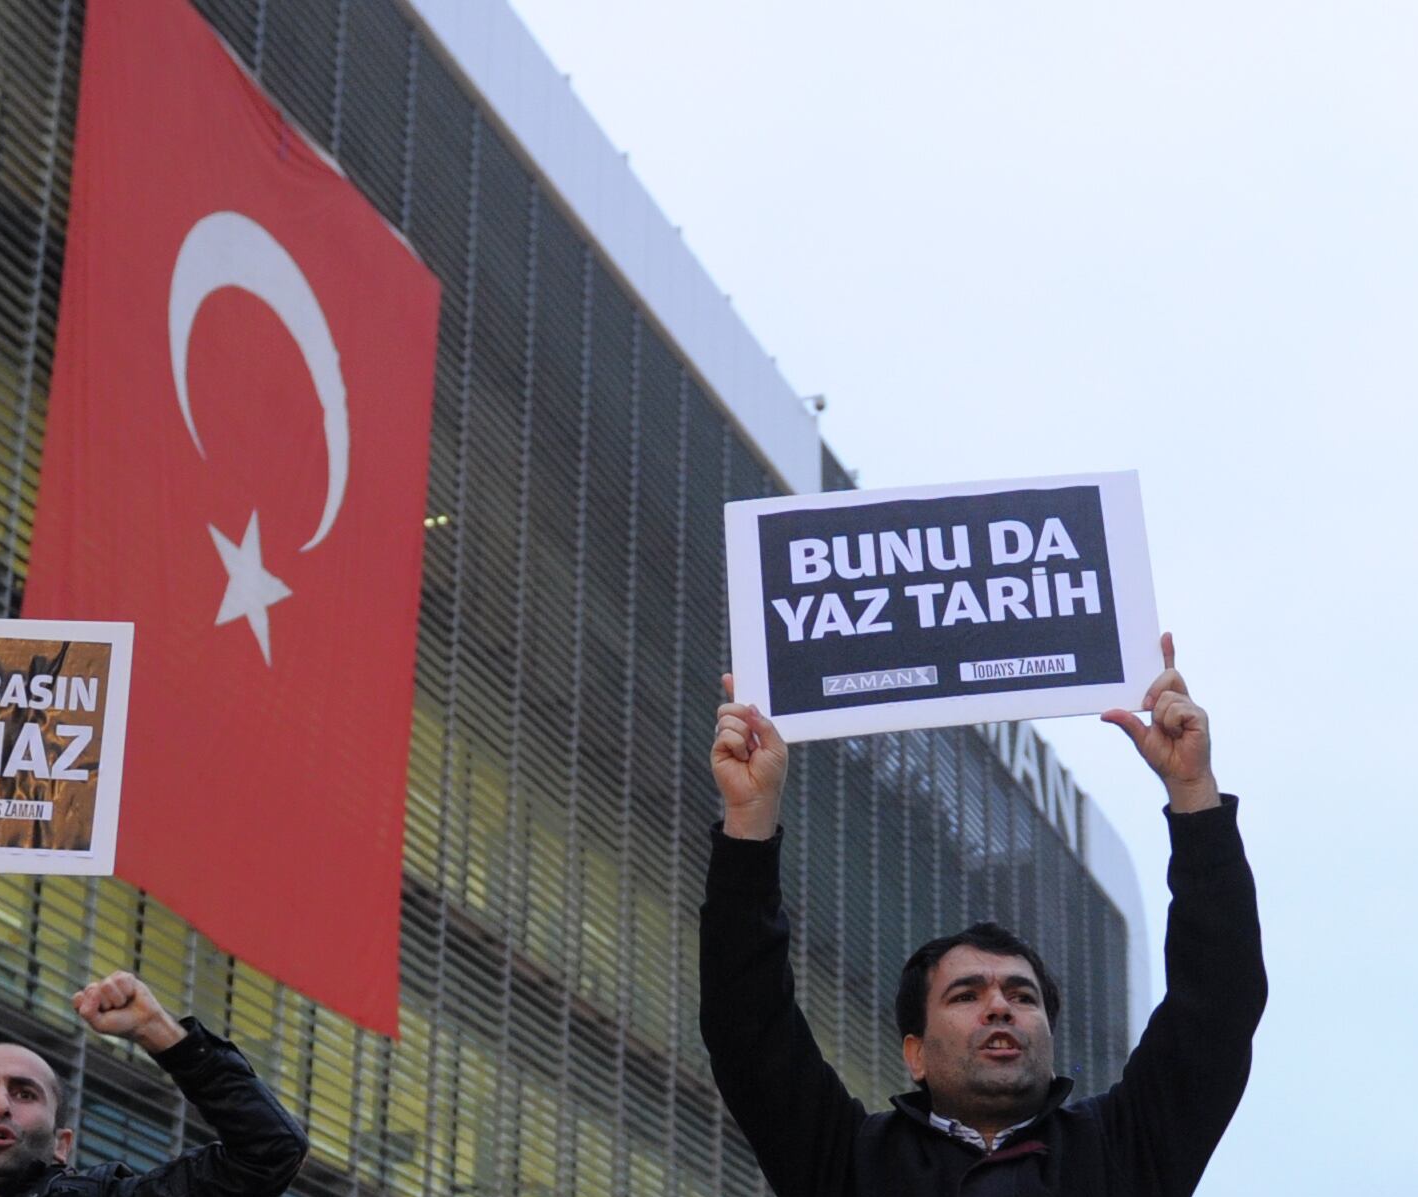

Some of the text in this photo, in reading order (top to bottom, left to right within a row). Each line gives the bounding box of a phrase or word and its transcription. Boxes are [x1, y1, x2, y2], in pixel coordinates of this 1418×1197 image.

[789, 517, 1080, 584] BUNU DA
[771, 567, 1102, 642] YAZ TARİH
[1018, 658, 1065, 675] ZAMAN
[828, 672, 912, 693] ZAMAN
[3, 801, 44, 817] ZAMAN
